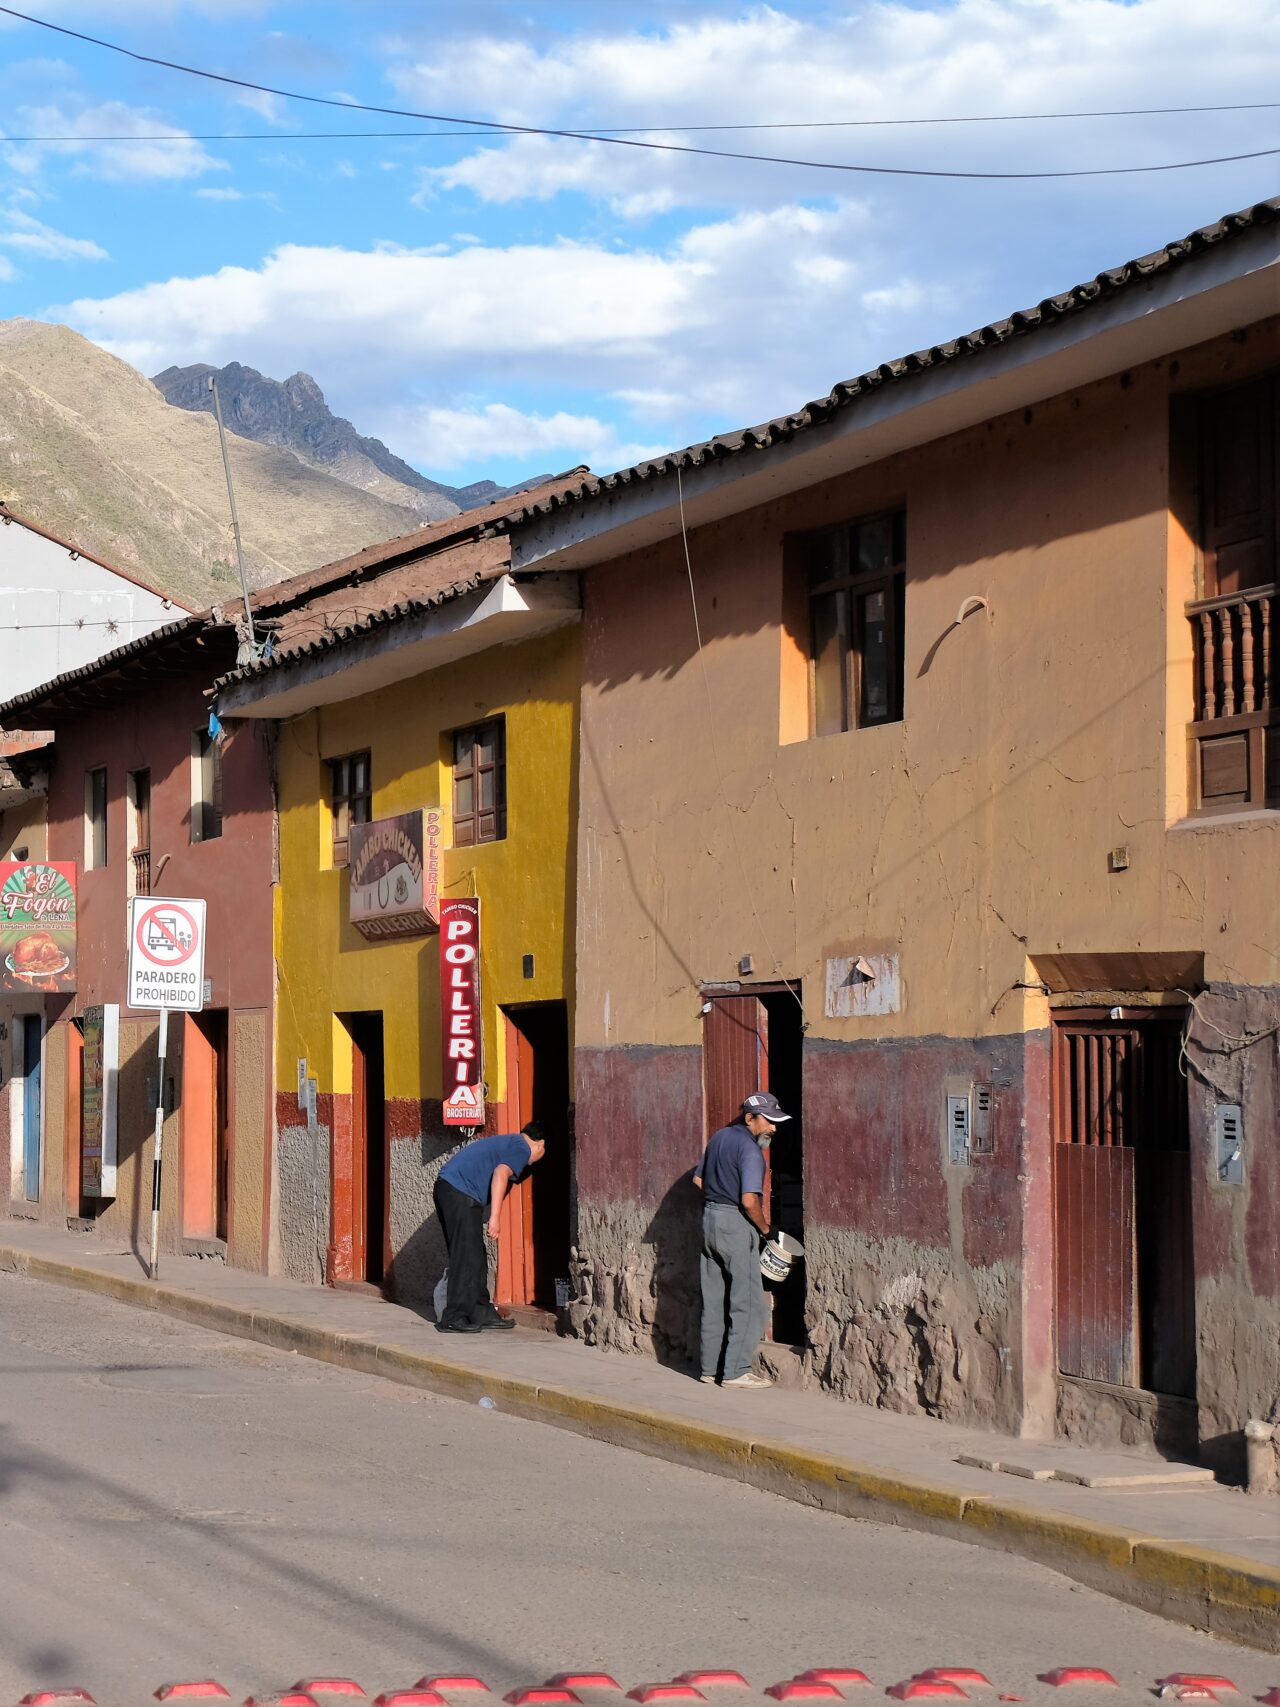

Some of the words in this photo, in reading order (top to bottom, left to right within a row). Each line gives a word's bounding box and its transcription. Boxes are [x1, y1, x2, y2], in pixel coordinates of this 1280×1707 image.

[351, 831, 381, 893] TAMBO
[383, 827, 422, 885] CHICKEN
[427, 812, 440, 907] POLLERIA
[35, 872, 56, 894] El
[2, 892, 71, 920] Fogón
[442, 904, 457, 915] TAMBO
[458, 904, 477, 915] CHICKEN
[360, 912, 433, 936] POLLERIA
[136, 970, 196, 984] PARADERO
[136, 988, 196, 1002] PROHIBIDO
[445, 920, 477, 1105] POLLERIA
[446, 1106, 480, 1118] BROSTERIA
